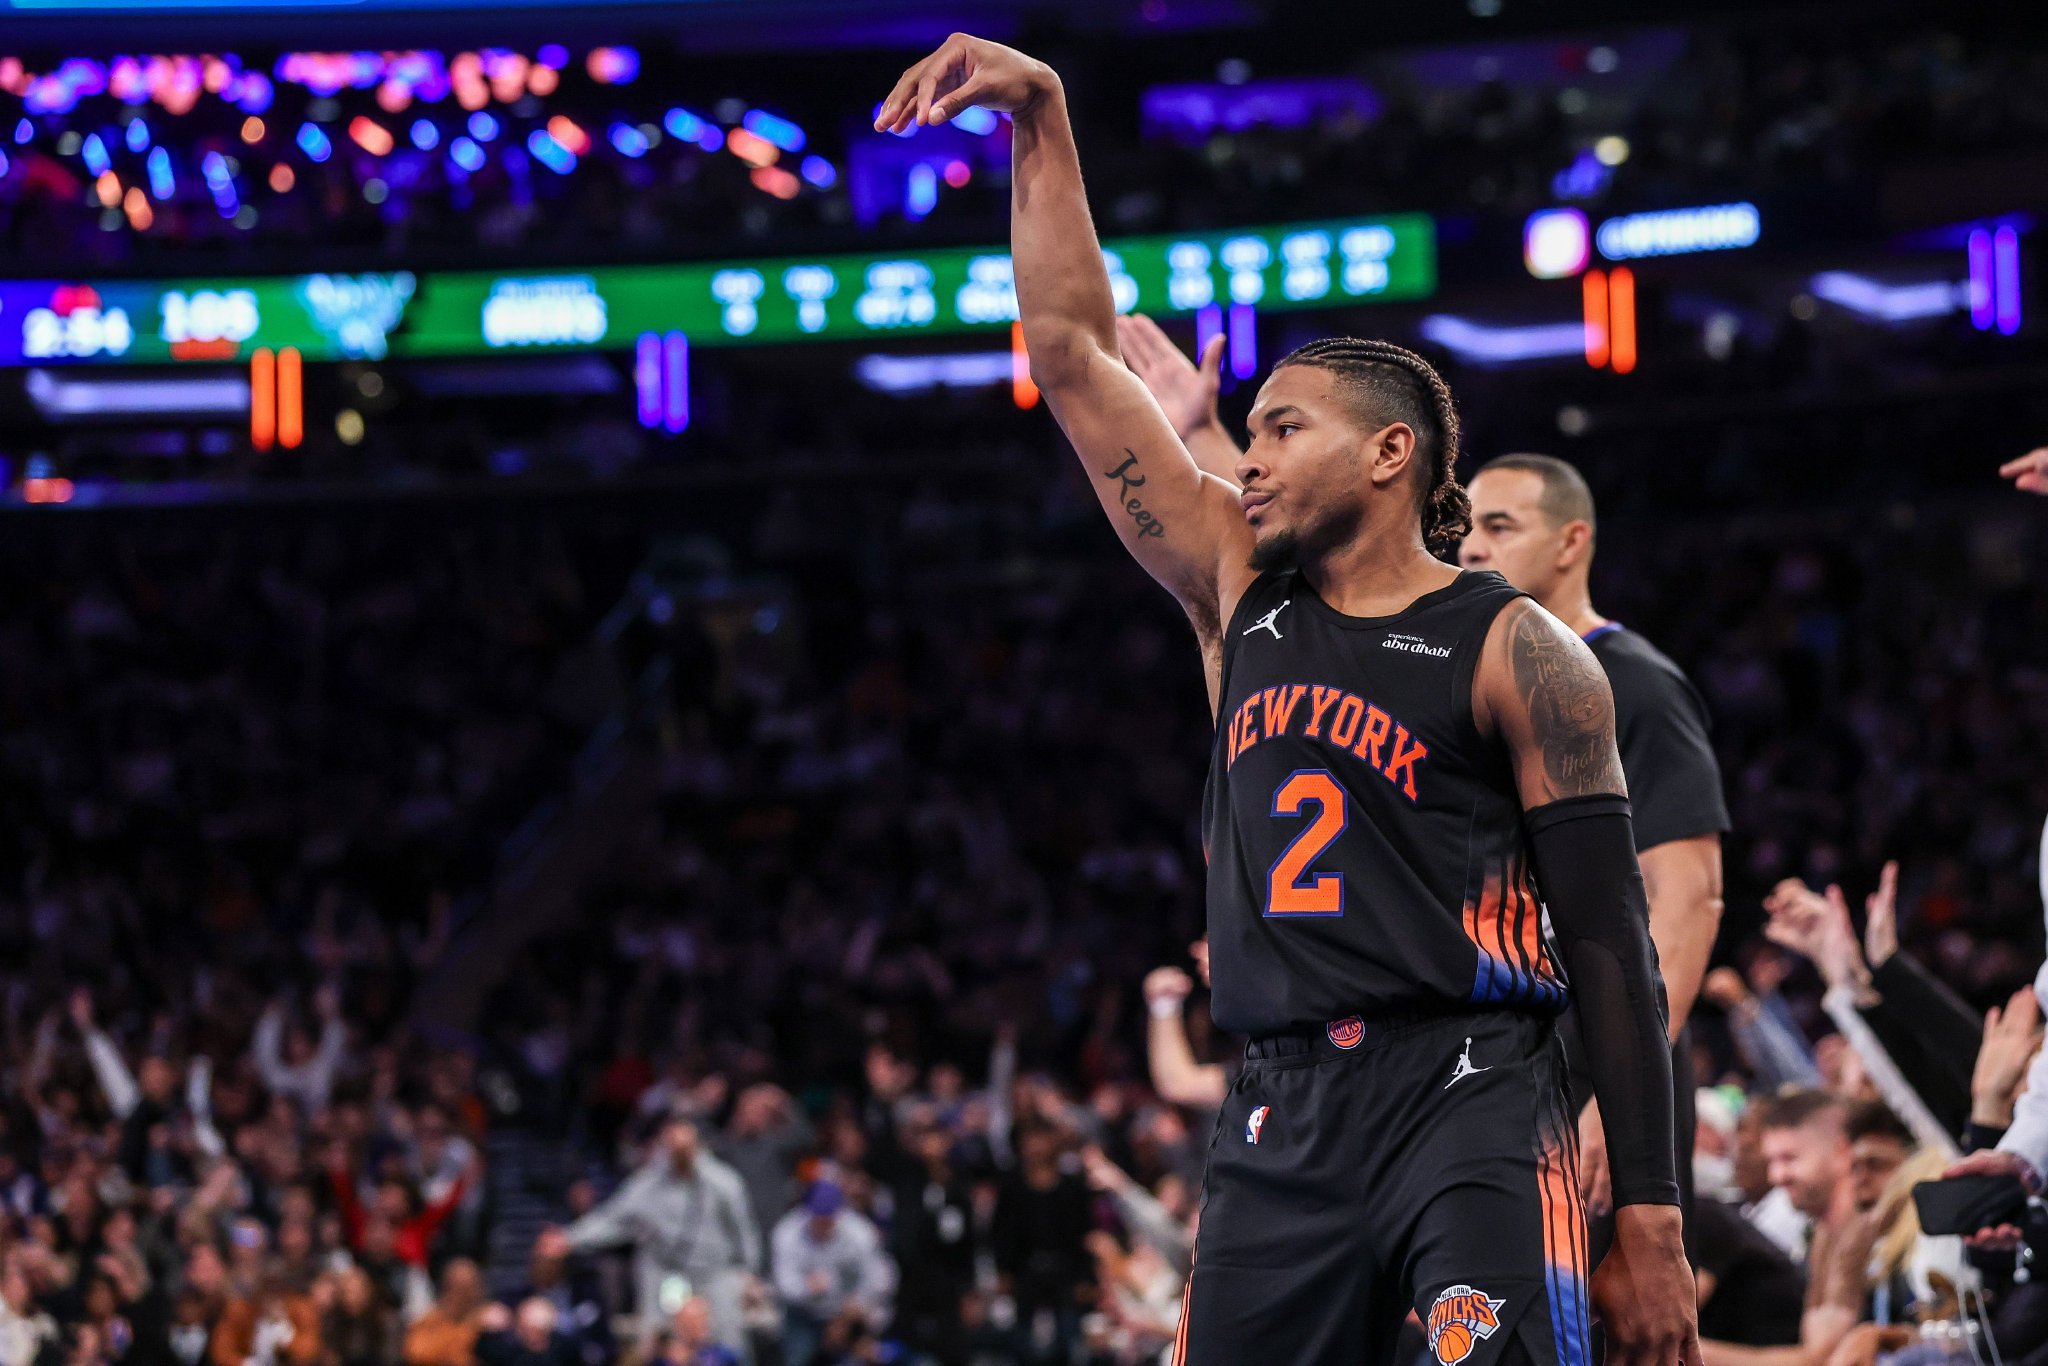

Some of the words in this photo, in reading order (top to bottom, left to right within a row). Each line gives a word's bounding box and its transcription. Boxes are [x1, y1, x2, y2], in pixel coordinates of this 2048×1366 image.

[1104, 447, 1164, 538] Keep
[1382, 639, 1409, 651] abu
[1410, 643, 1452, 658] dhabi
[1388, 633, 1424, 642] experience
[1227, 684, 1307, 773] NEW
[1303, 684, 1428, 804] YORK
[1263, 769, 1348, 917] 2
[1453, 1287, 1470, 1296] YORK
[1430, 1293, 1497, 1336] KNICKS
